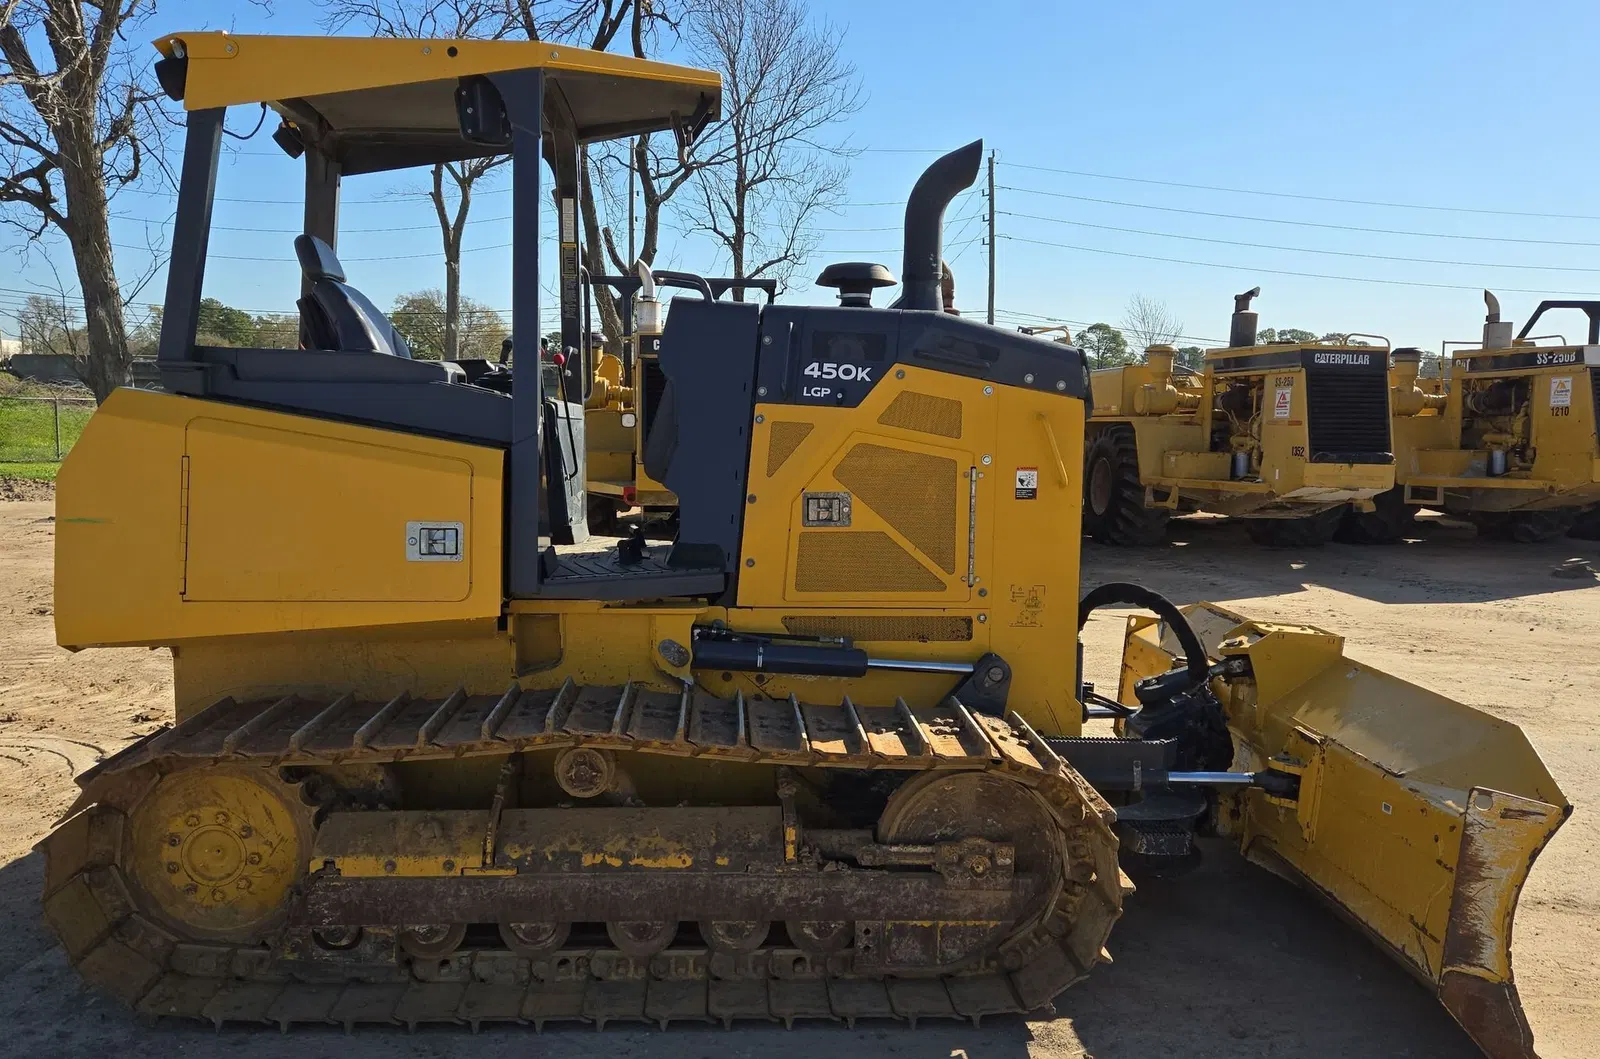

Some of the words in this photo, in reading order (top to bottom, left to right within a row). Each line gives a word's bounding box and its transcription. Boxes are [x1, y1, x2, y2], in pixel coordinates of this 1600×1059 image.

[1314, 352, 1370, 365] CATERPILLAR
[804, 362, 872, 381] 450K
[803, 386, 831, 398] LGP
[1550, 406, 1570, 417] 1210
